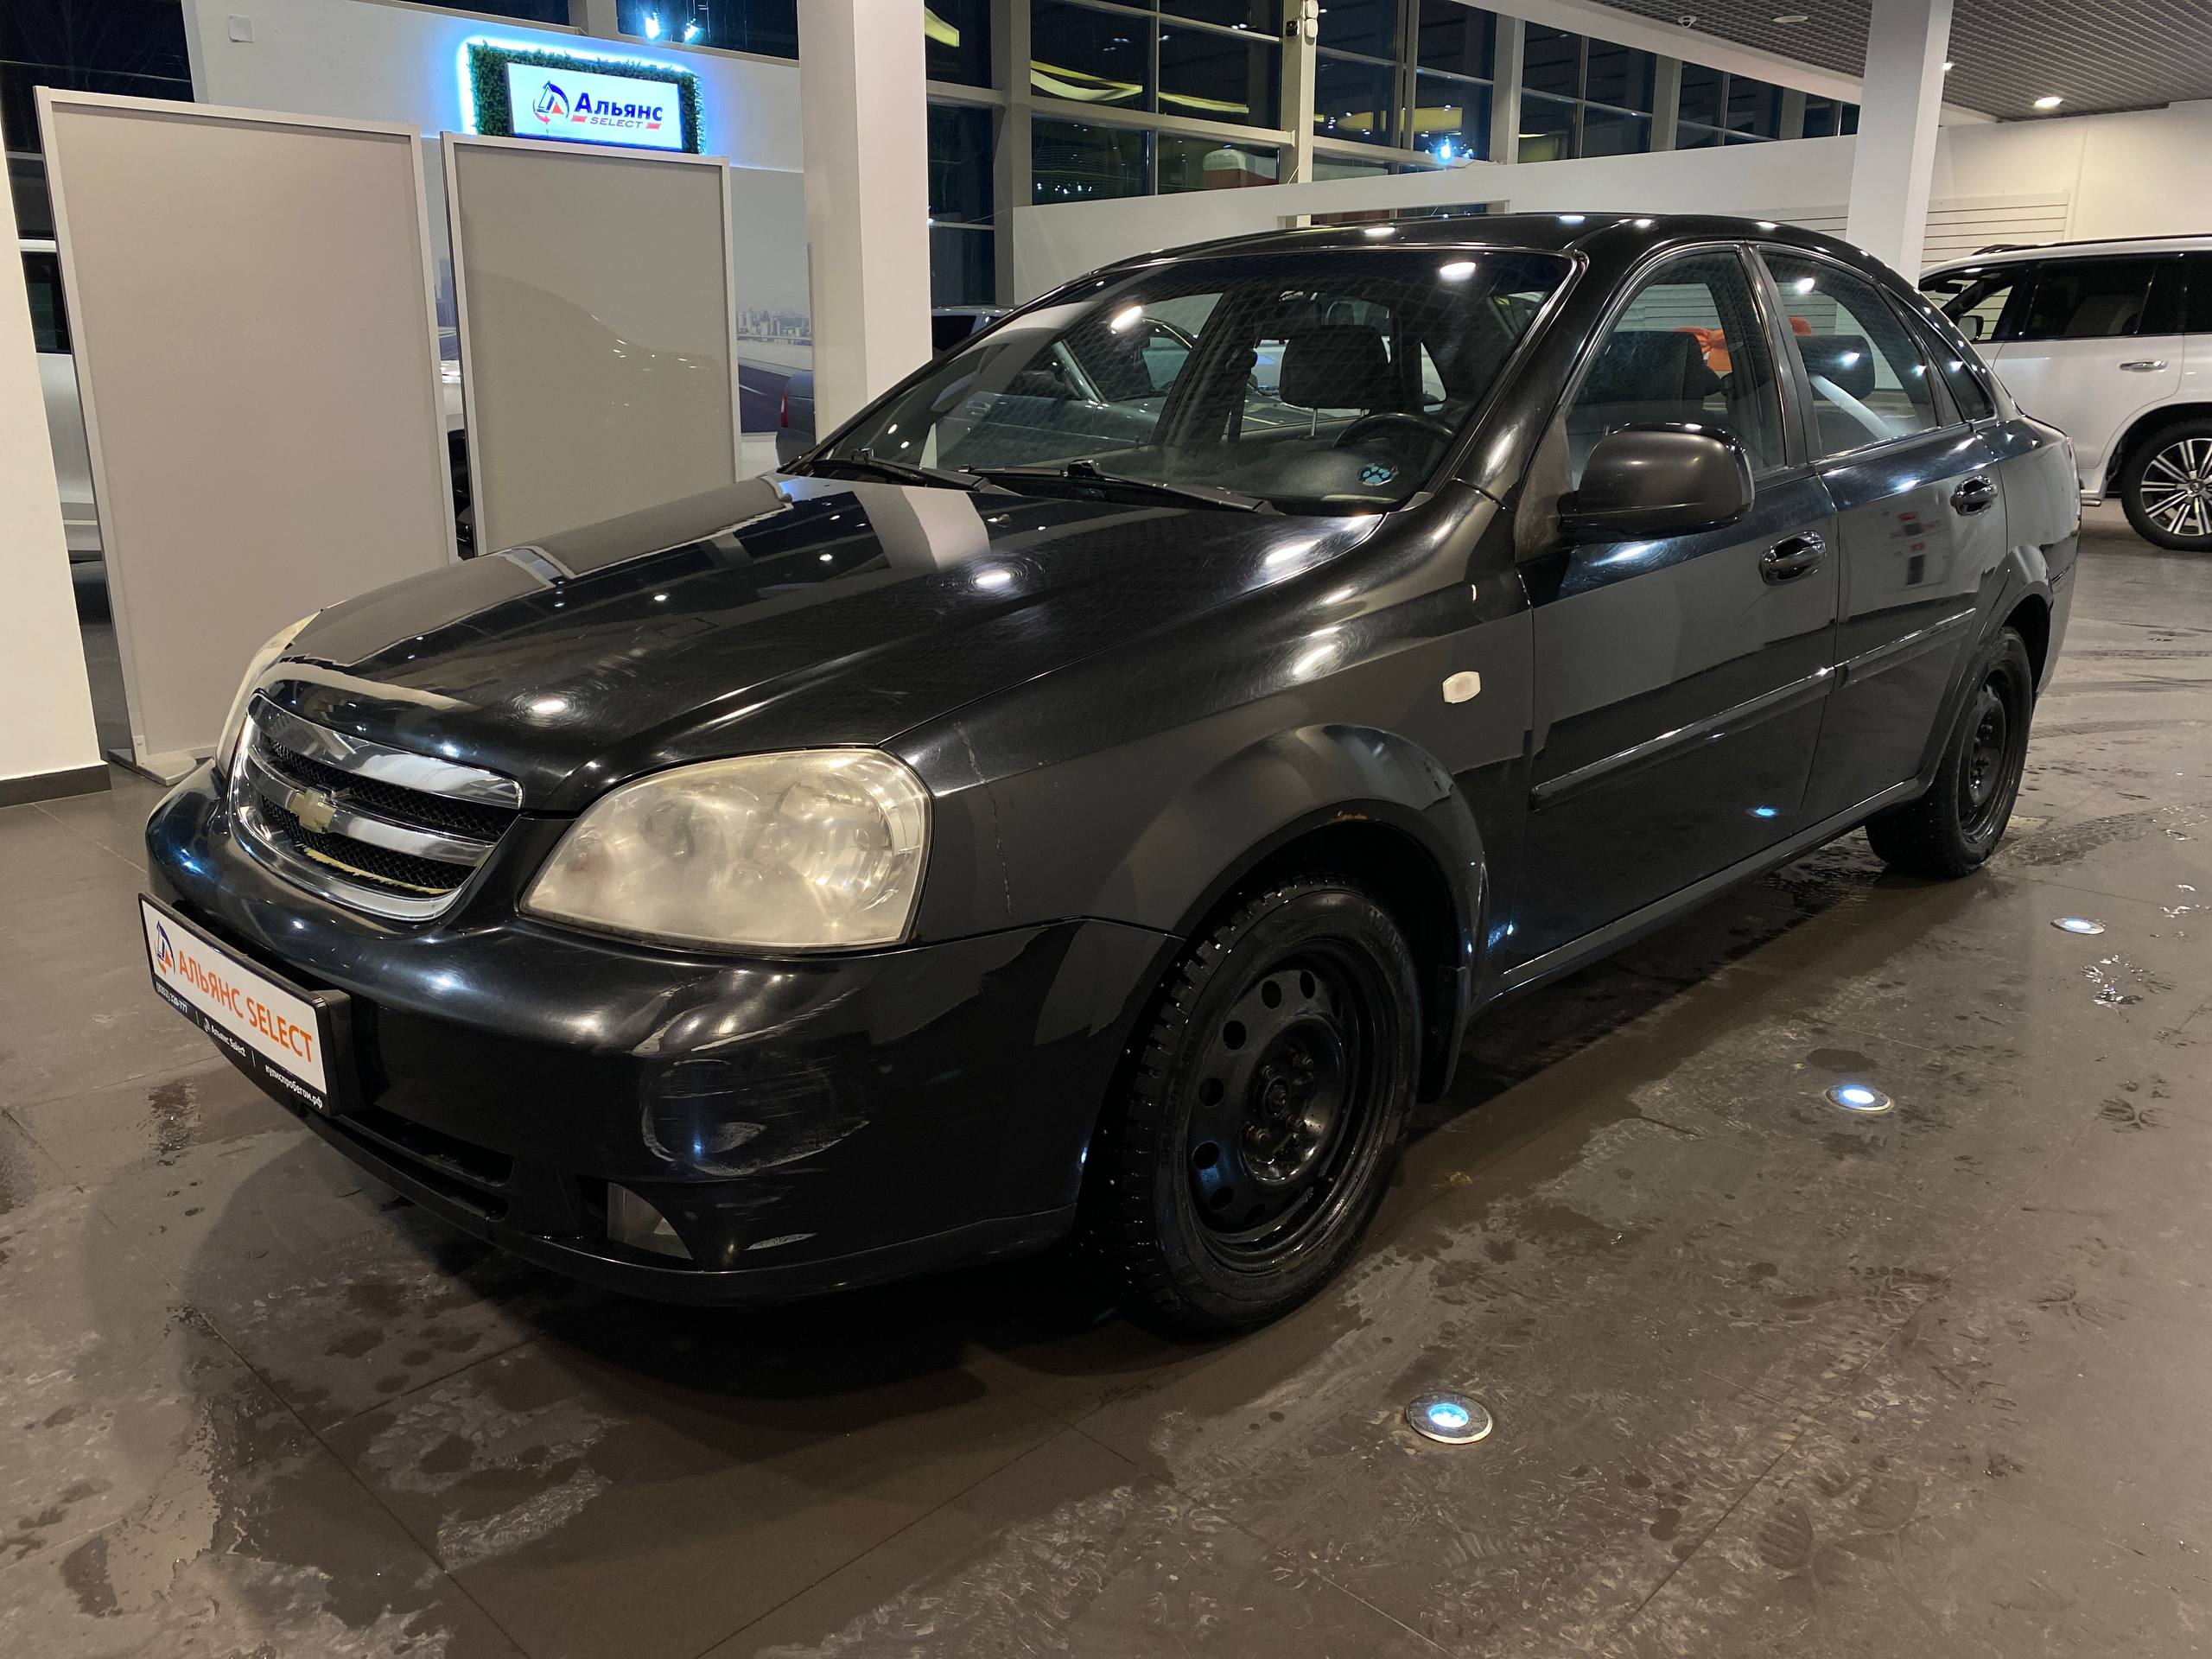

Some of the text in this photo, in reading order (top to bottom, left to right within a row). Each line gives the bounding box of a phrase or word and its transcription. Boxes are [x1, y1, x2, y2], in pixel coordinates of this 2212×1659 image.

[574, 92, 663, 121] Альянс
[589, 117, 644, 129] SELECT
[180, 950, 313, 1063] АЛЬЯНС SELECT
